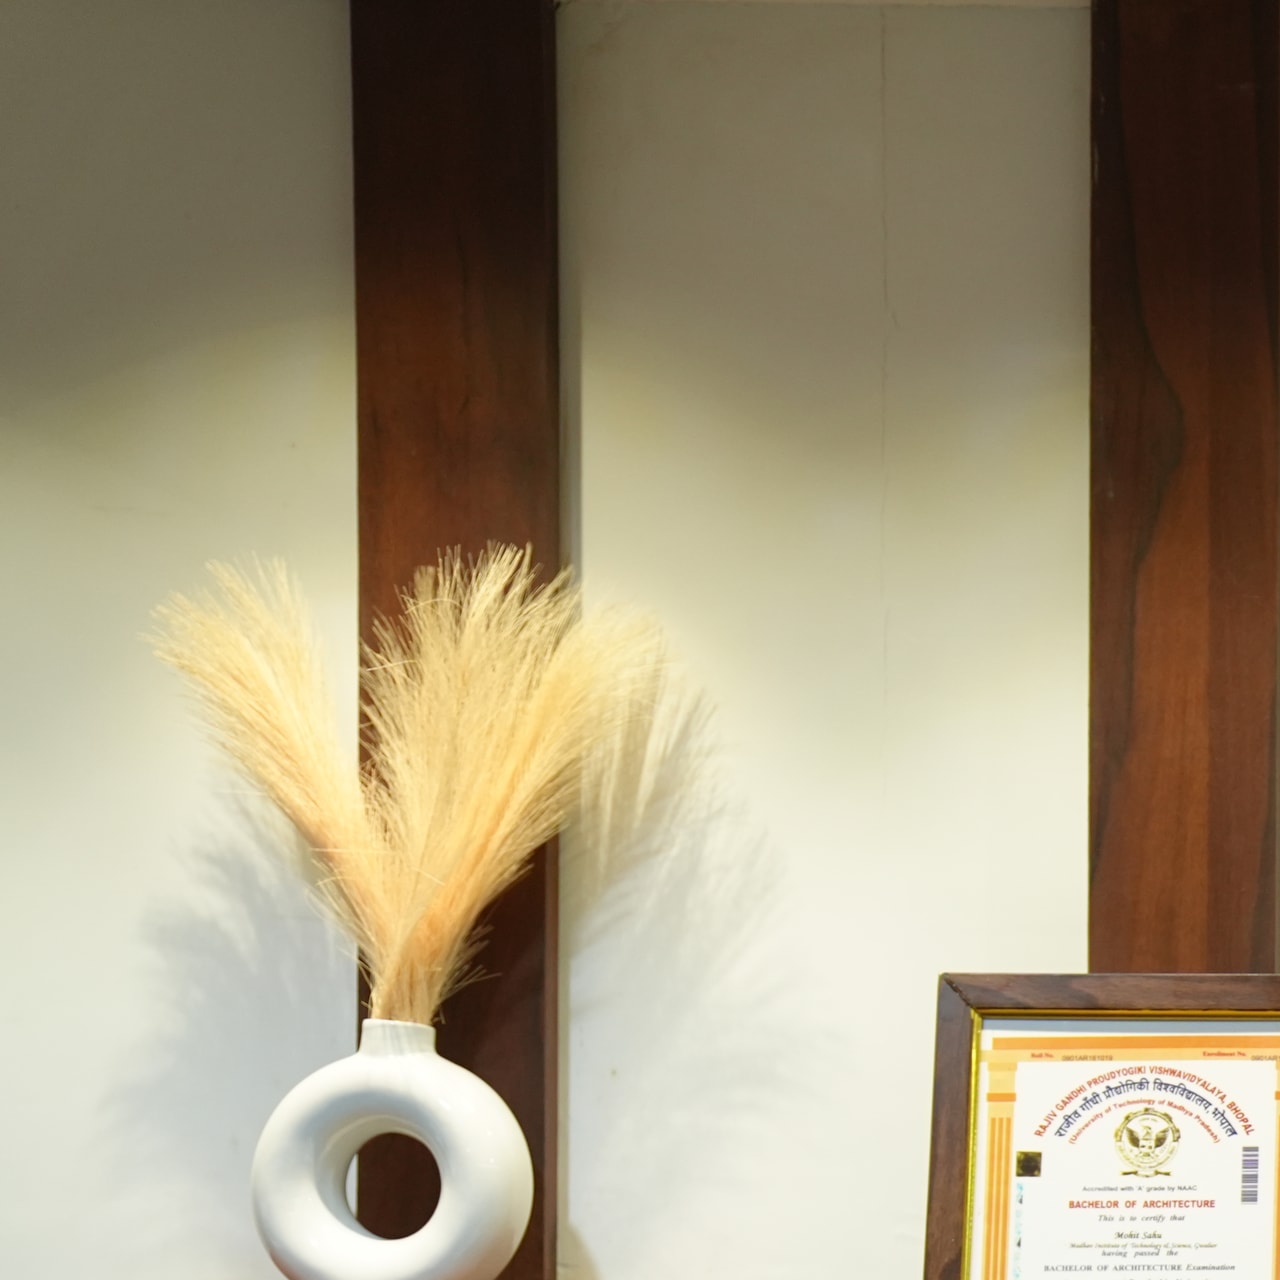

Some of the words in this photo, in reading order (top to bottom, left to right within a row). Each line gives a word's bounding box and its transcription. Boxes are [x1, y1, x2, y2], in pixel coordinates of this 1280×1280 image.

[1034, 1111, 1057, 1137] RAJIV
[1056, 1085, 1087, 1111] GANDHI
[1087, 1066, 1146, 1088] PROUDYOGIKI
[1150, 1066, 1226, 1103] VISHWAVIDYALAYA,
[1227, 1101, 1254, 1136] BHOPAL
[1054, 1110, 1081, 1137] राजीव
[1103, 1078, 1149, 1100] प्रौद्योगिकी
[1212, 1107, 1238, 1137] भोपाल
[1114, 1099, 1155, 1110] Technology
[1167, 1100, 1193, 1117] Madhya
[1069, 1200, 1119, 1208] BACHELOR
[1125, 1200, 1137, 1208] OF
[1143, 1200, 1215, 1208] ARCHITECTURE
[1142, 1215, 1165, 1223] certify
